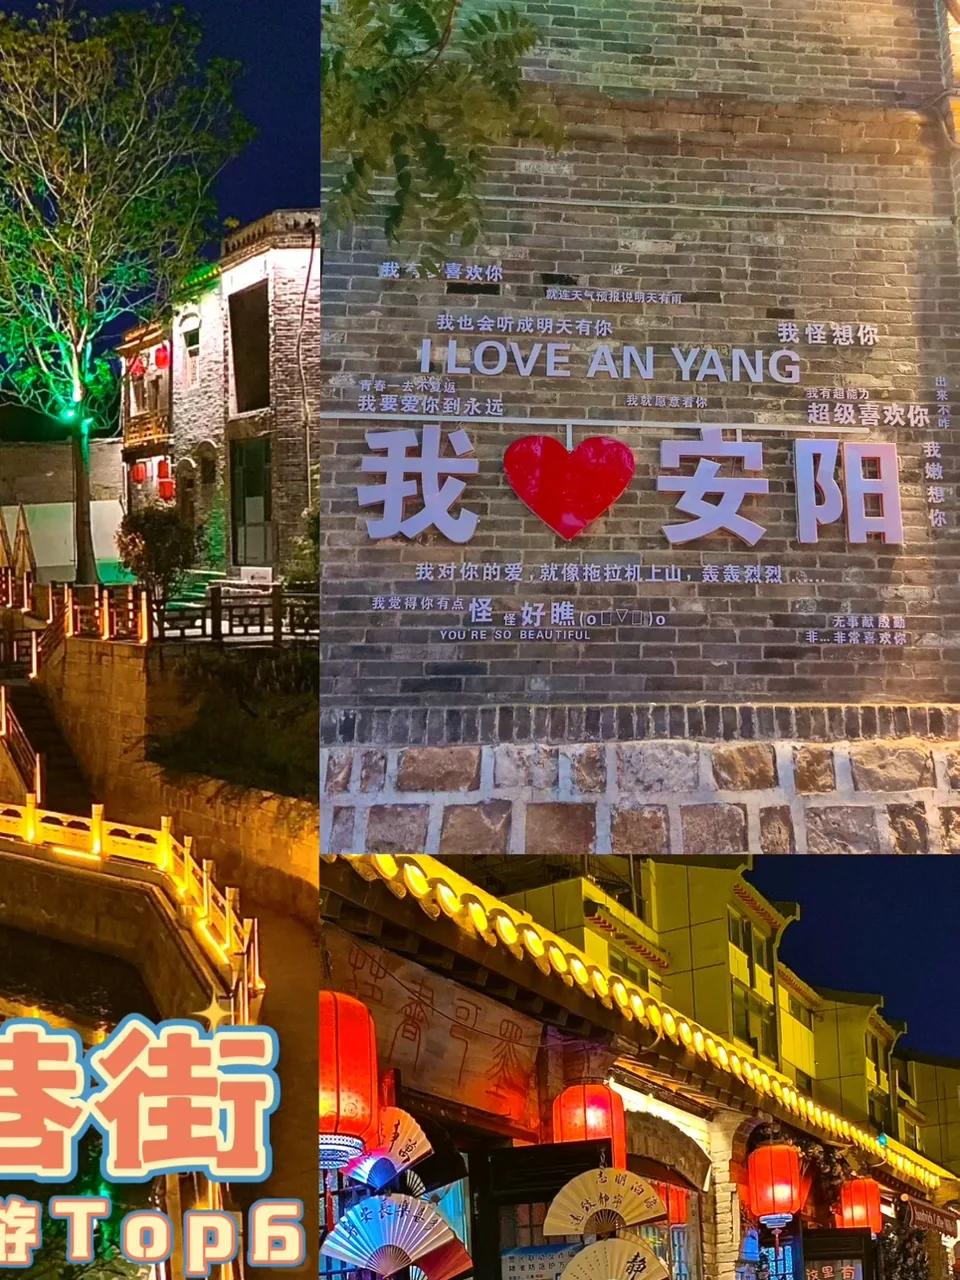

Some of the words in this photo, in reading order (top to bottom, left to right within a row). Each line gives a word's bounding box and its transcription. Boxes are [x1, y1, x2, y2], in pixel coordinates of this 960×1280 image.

[437, 315, 613, 336] 我也会听成明天有你
[777, 322, 879, 346] 我怪想你
[420, 338, 432, 373] I
[447, 339, 571, 377] LOVE
[587, 344, 654, 380] AN
[672, 347, 800, 384] YANG
[358, 394, 504, 416] 我要爱你到永远
[806, 388, 869, 400] 我有超能力
[807, 402, 930, 428] 超级喜欢你
[357, 424, 480, 543] 我
[656, 424, 904, 546] 安阳
[832, 615, 905, 630] 无事献殷勤
[494, 630, 512, 641] SO
[519, 630, 591, 641] BEAUTIFUL
